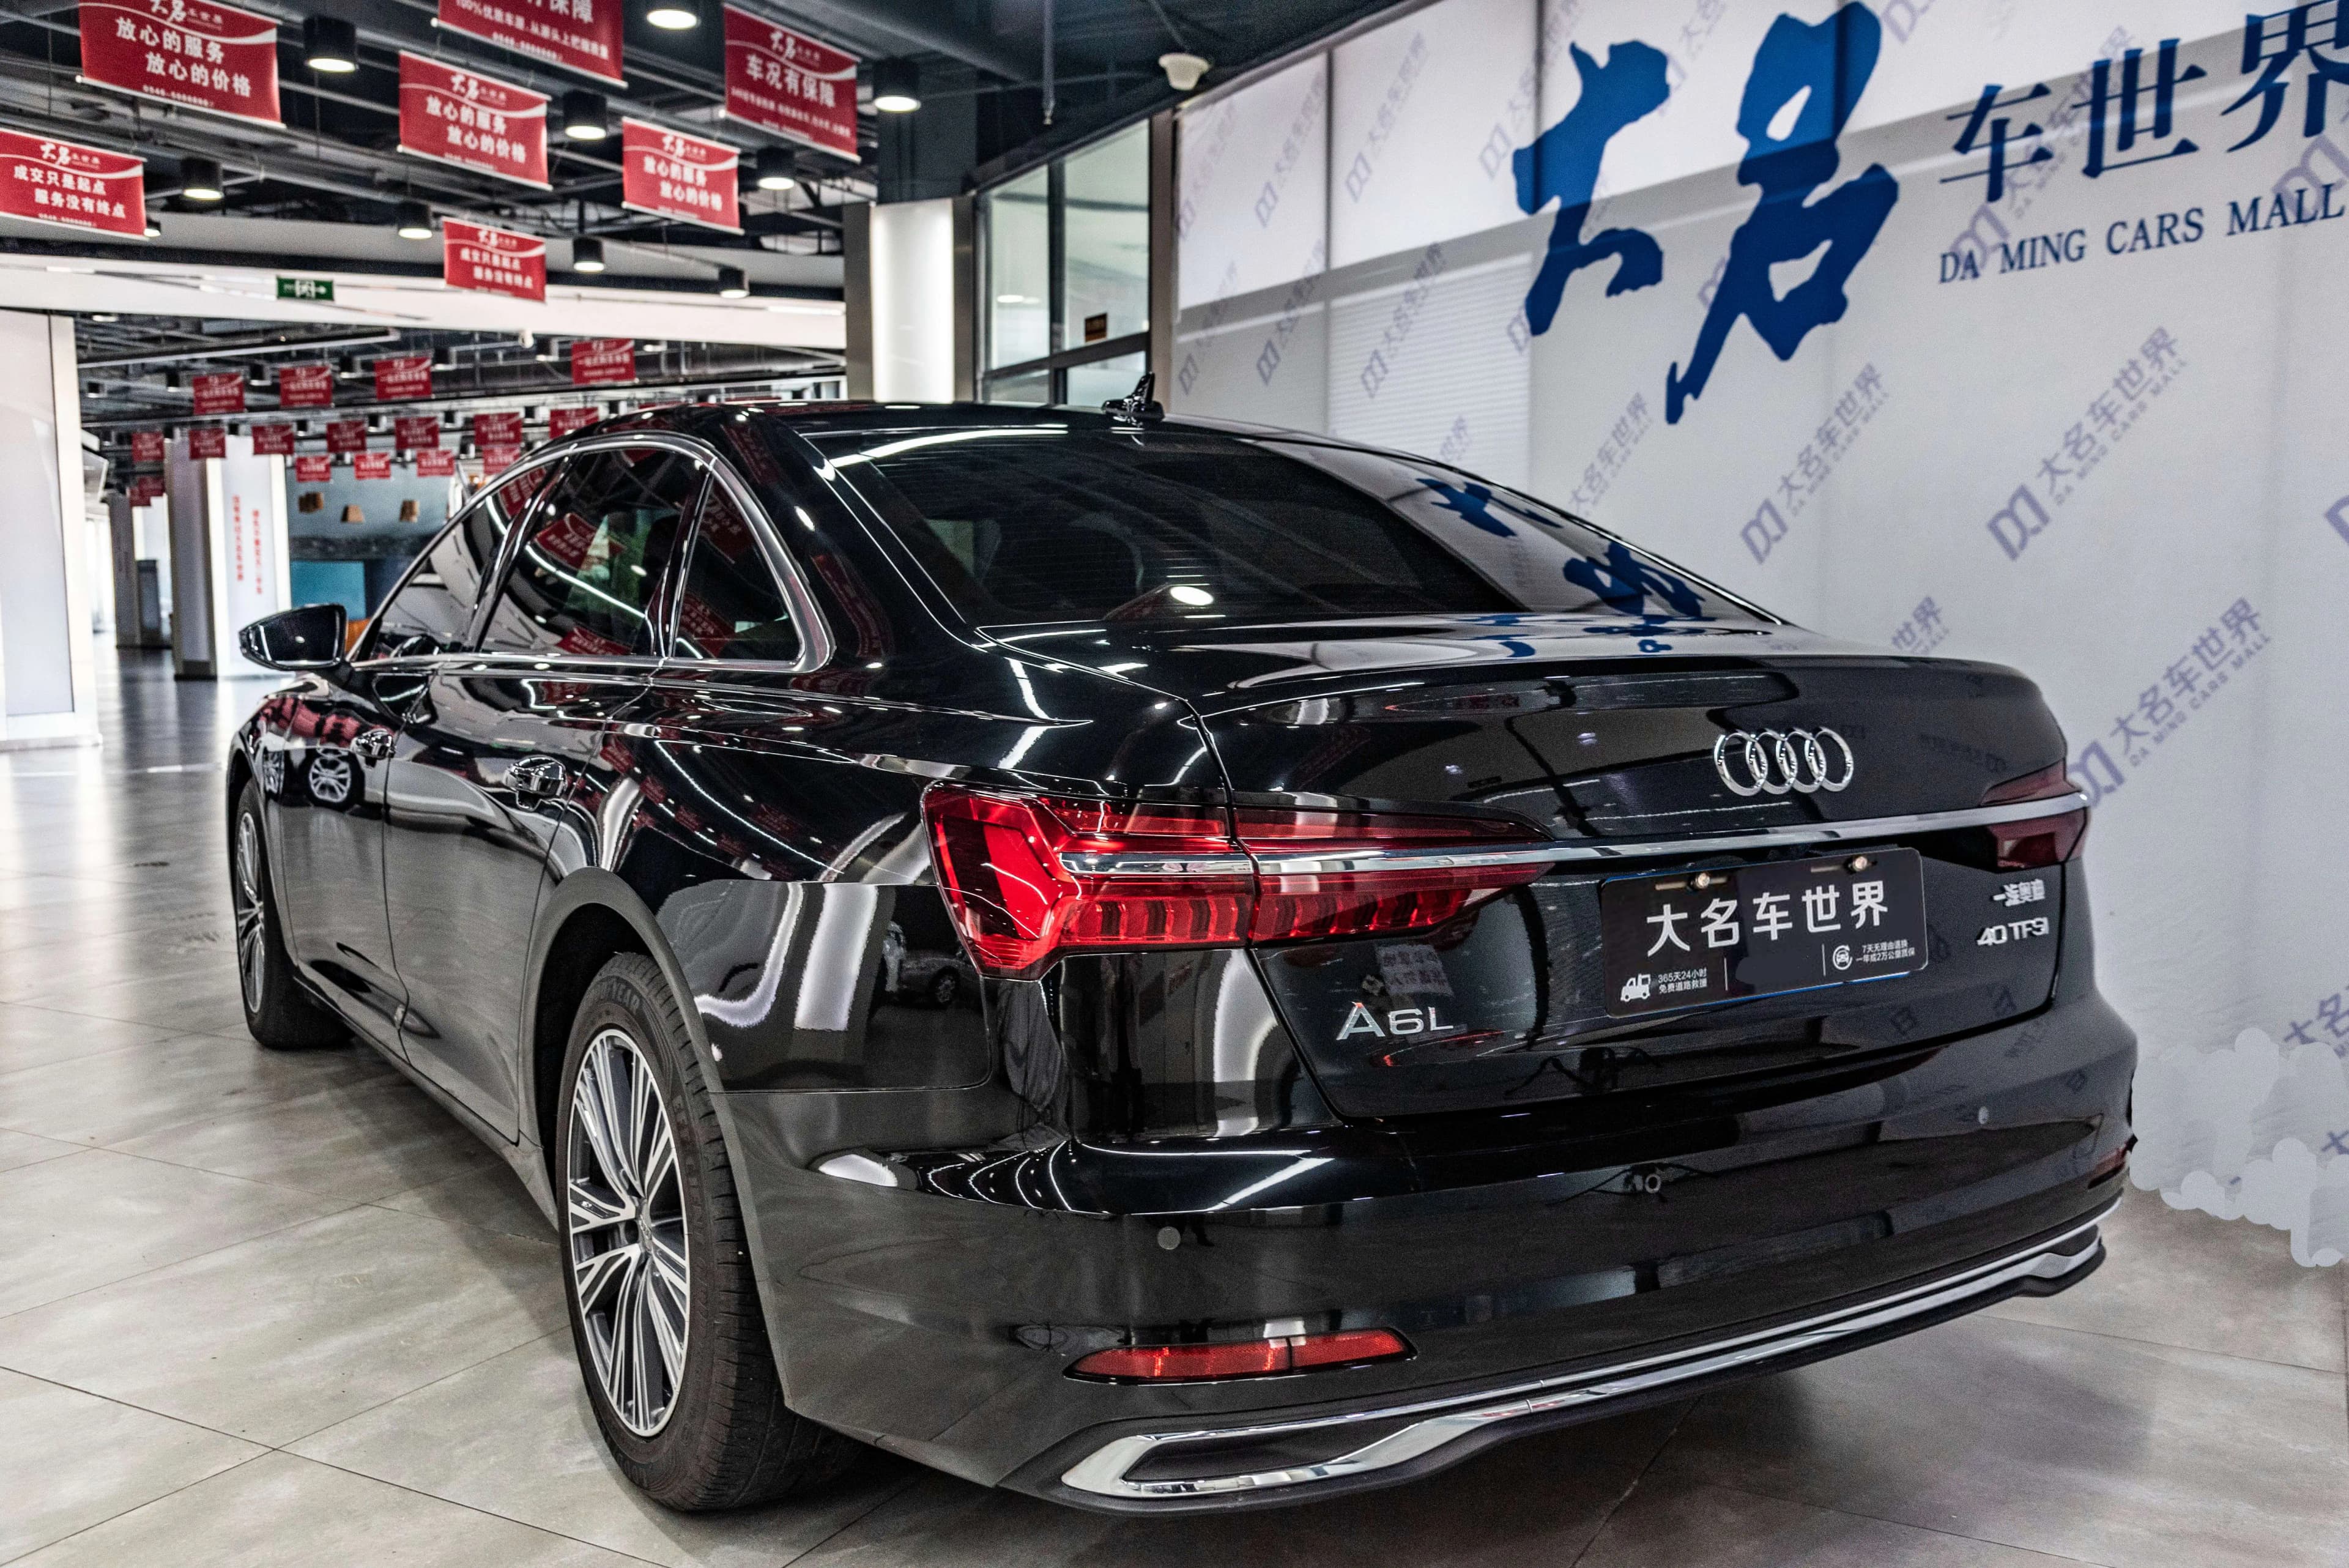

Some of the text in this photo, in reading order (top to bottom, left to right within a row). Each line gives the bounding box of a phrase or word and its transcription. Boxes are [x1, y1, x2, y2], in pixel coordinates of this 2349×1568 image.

[114, 16, 225, 65] 放心的服务
[144, 51, 251, 98] 放心的价格
[745, 53, 836, 108] 车况有保障
[426, 94, 507, 136] 放心的服务
[447, 123, 527, 164] 放心的价格
[13, 164, 107, 196] 成交只是起点
[34, 187, 127, 219] 服务没有终点
[1939, 182, 2347, 284] DA MING CARS MALL
[2036, 326, 2179, 494] 大名车世界
[1776, 362, 1883, 510] 大名车世界
[2230, 632, 2271, 672] MALL
[2104, 596, 2262, 756] 大名车世界
[1992, 878, 2046, 907] 一汽奥迪
[1646, 880, 1888, 957] 大名车世界
[1976, 916, 2050, 946] 40 TFSI
[1658, 967, 1707, 984] 365天24小时
[1658, 978, 1708, 994] 免费道路救援
[1336, 1001, 1455, 1041] A6L
